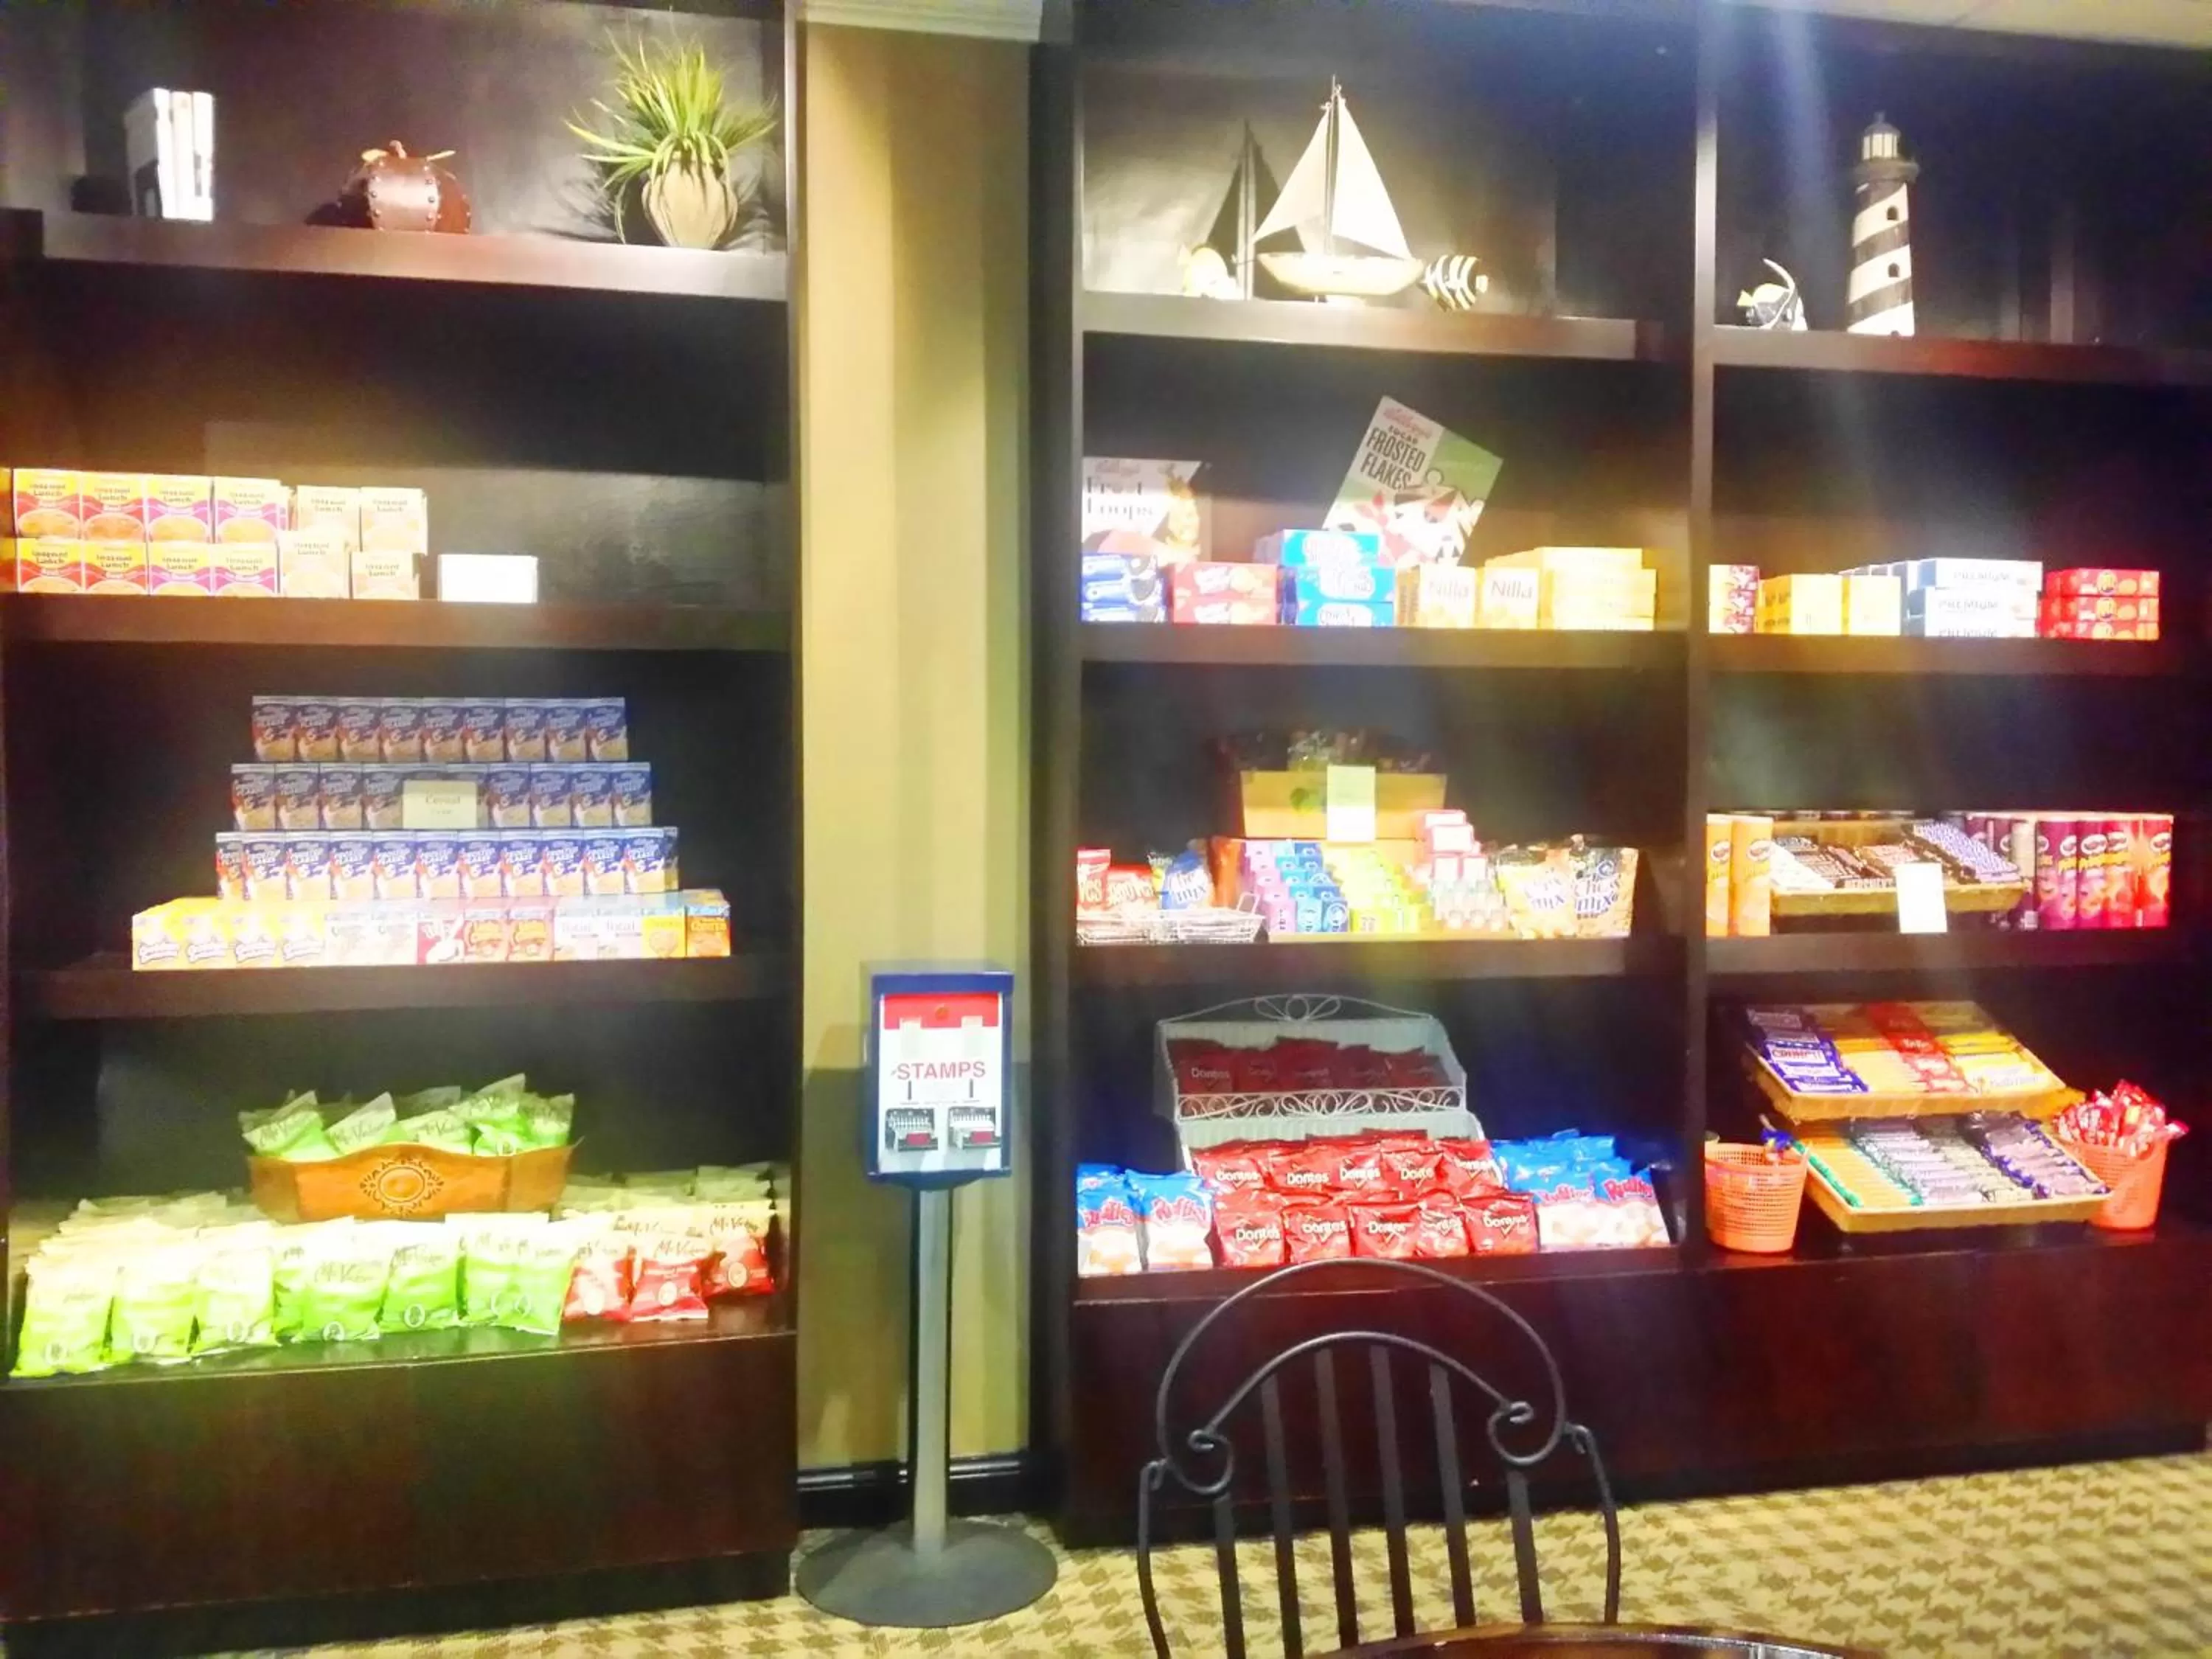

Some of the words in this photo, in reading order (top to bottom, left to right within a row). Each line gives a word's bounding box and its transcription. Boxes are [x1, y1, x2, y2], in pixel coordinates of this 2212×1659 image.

[1367, 427, 1427, 473] FROSTED
[1360, 451, 1412, 490] FLAKES
[1491, 580, 1533, 600] Nilla
[897, 1061, 987, 1080] STAMPS
[1192, 1068, 1230, 1079] Doritos
[1287, 1172, 1329, 1185] Doritos
[1340, 1167, 1381, 1182] Doritos
[1236, 1226, 1281, 1242] Doritos
[1301, 1220, 1346, 1234] Doritos
